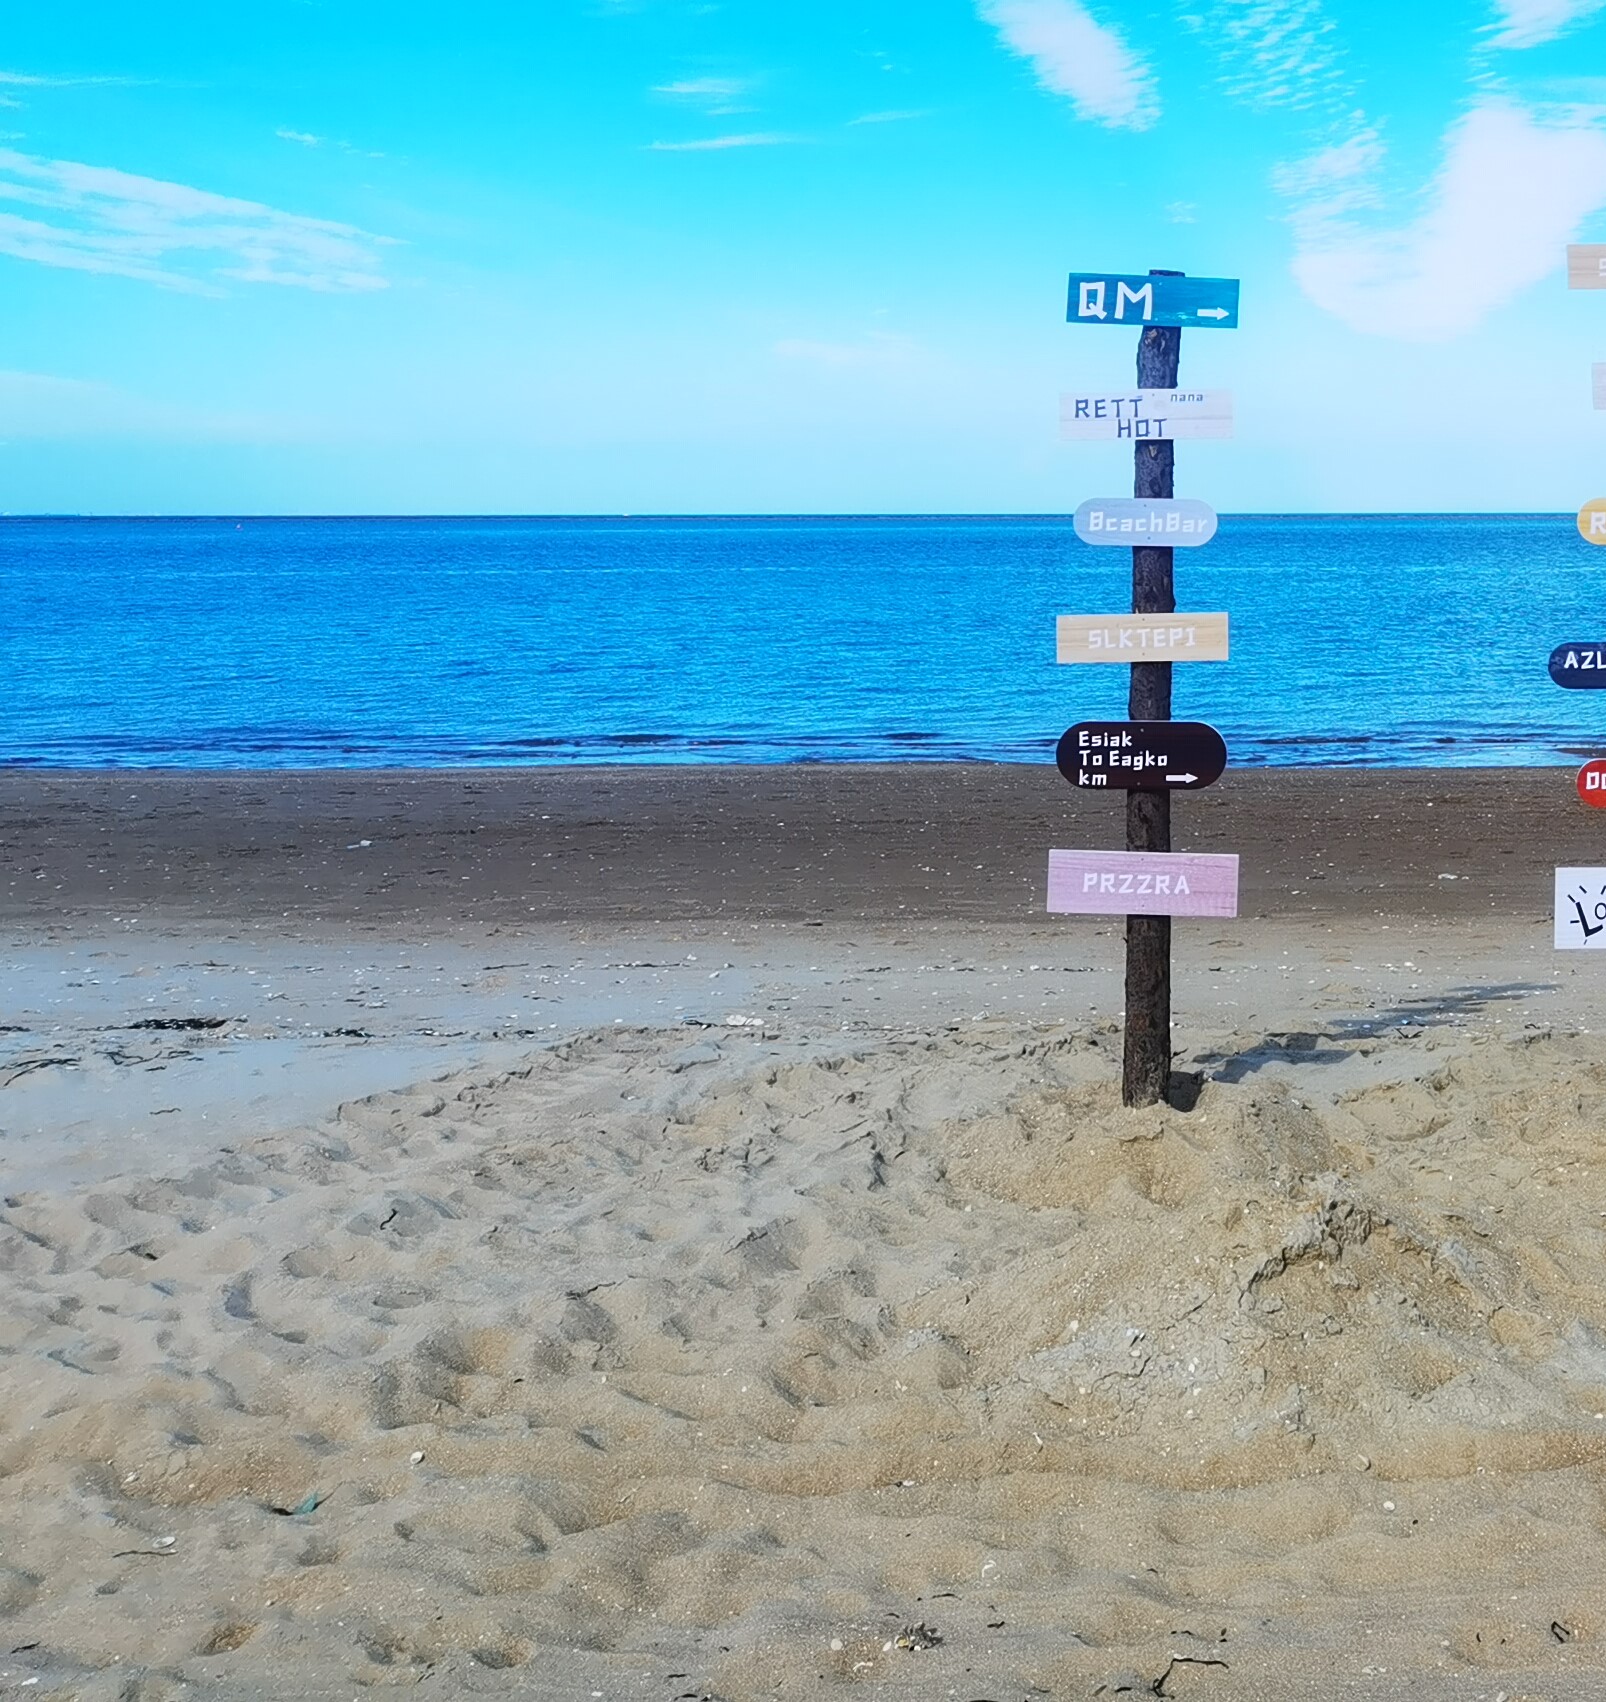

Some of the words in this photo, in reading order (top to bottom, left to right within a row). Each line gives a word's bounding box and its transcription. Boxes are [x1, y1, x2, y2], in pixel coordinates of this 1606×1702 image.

[1078, 281, 1153, 320] QM
[1074, 398, 1143, 418] RETT
[1117, 418, 1167, 438] HOT
[1088, 627, 1196, 649] SLKTEPI
[1078, 731, 1133, 747] Esiak
[1079, 750, 1103, 766] To
[1109, 750, 1168, 770] Eagko
[1079, 769, 1107, 785] km
[1082, 872, 1191, 895] PRZZRA
